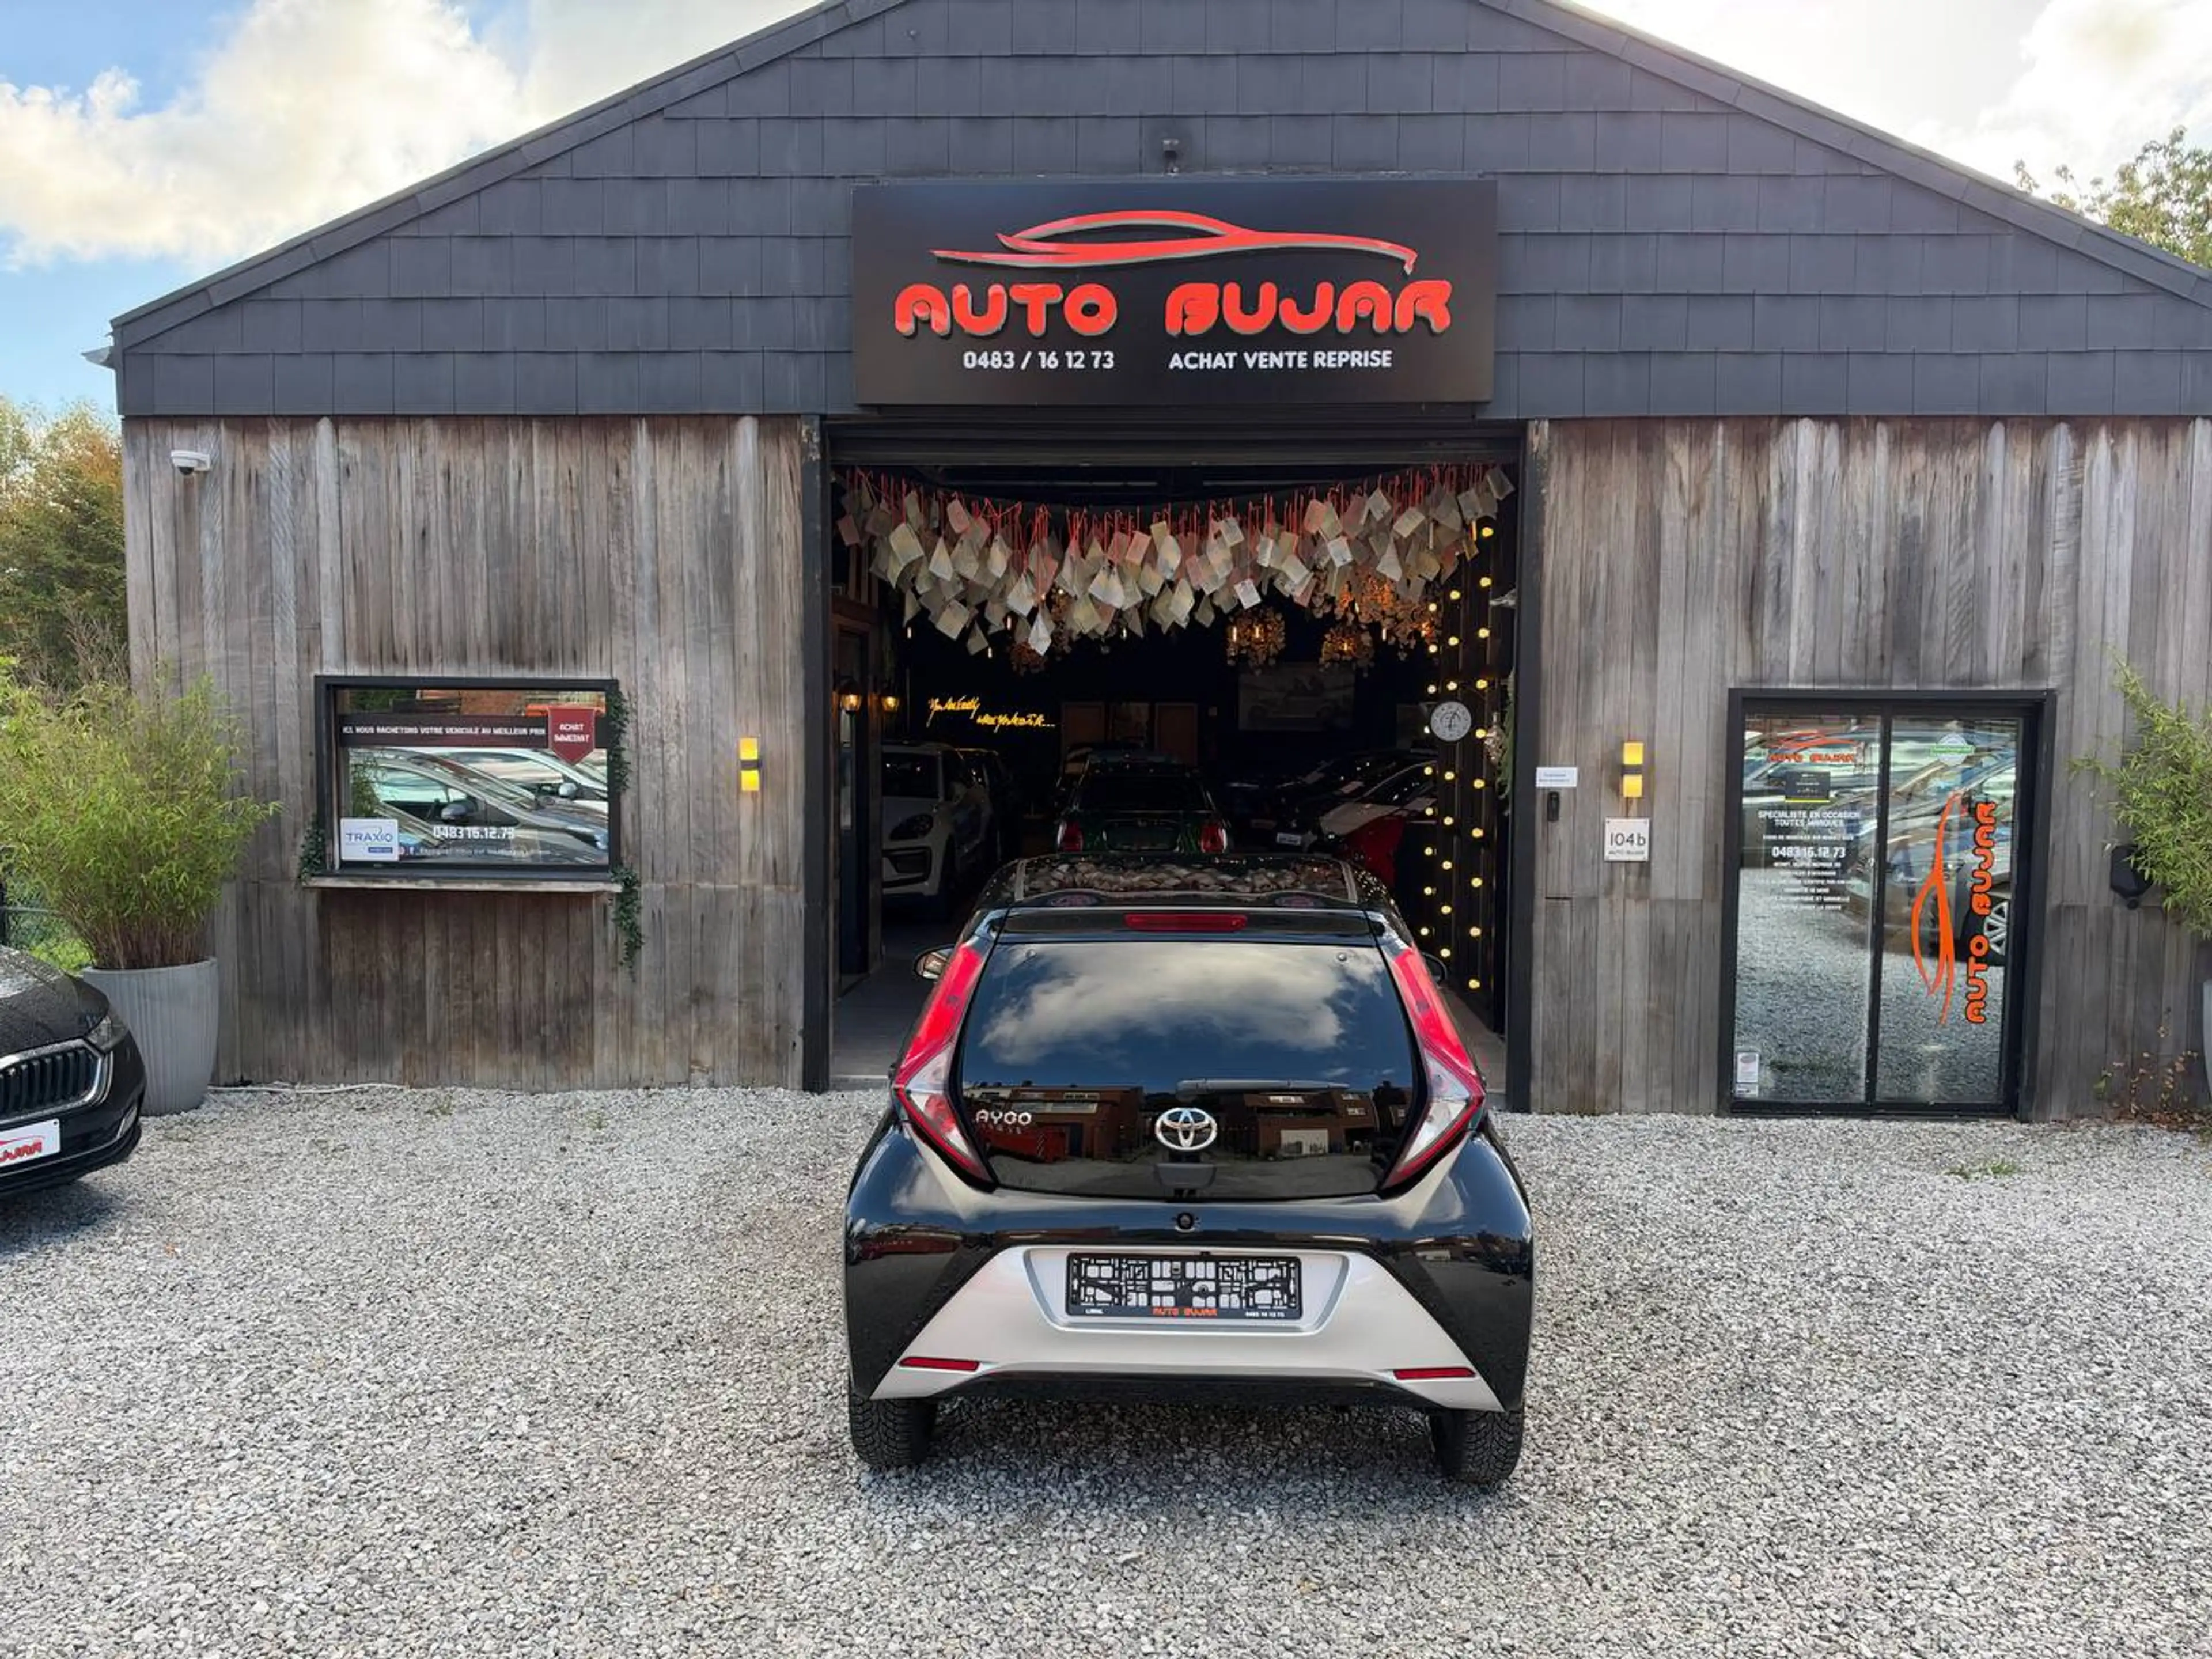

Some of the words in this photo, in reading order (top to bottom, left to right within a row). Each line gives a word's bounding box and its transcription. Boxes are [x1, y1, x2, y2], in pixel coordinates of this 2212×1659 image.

[895, 283, 1118, 337] AUTO
[1164, 278, 1452, 335] BUJAR
[963, 351, 1016, 369] 0483
[1020, 351, 1032, 370] /
[1038, 351, 1059, 369] 16
[1065, 351, 1085, 369] 12
[1090, 351, 1115, 369] 73
[1169, 351, 1237, 370] ACHAT
[1244, 351, 1308, 369] VENTE
[1313, 350, 1393, 368] REPRISE
[1971, 802, 1996, 915] BUJAR
[1966, 934, 1990, 1023] AUTO
[975, 1109, 1032, 1126] AYGO
